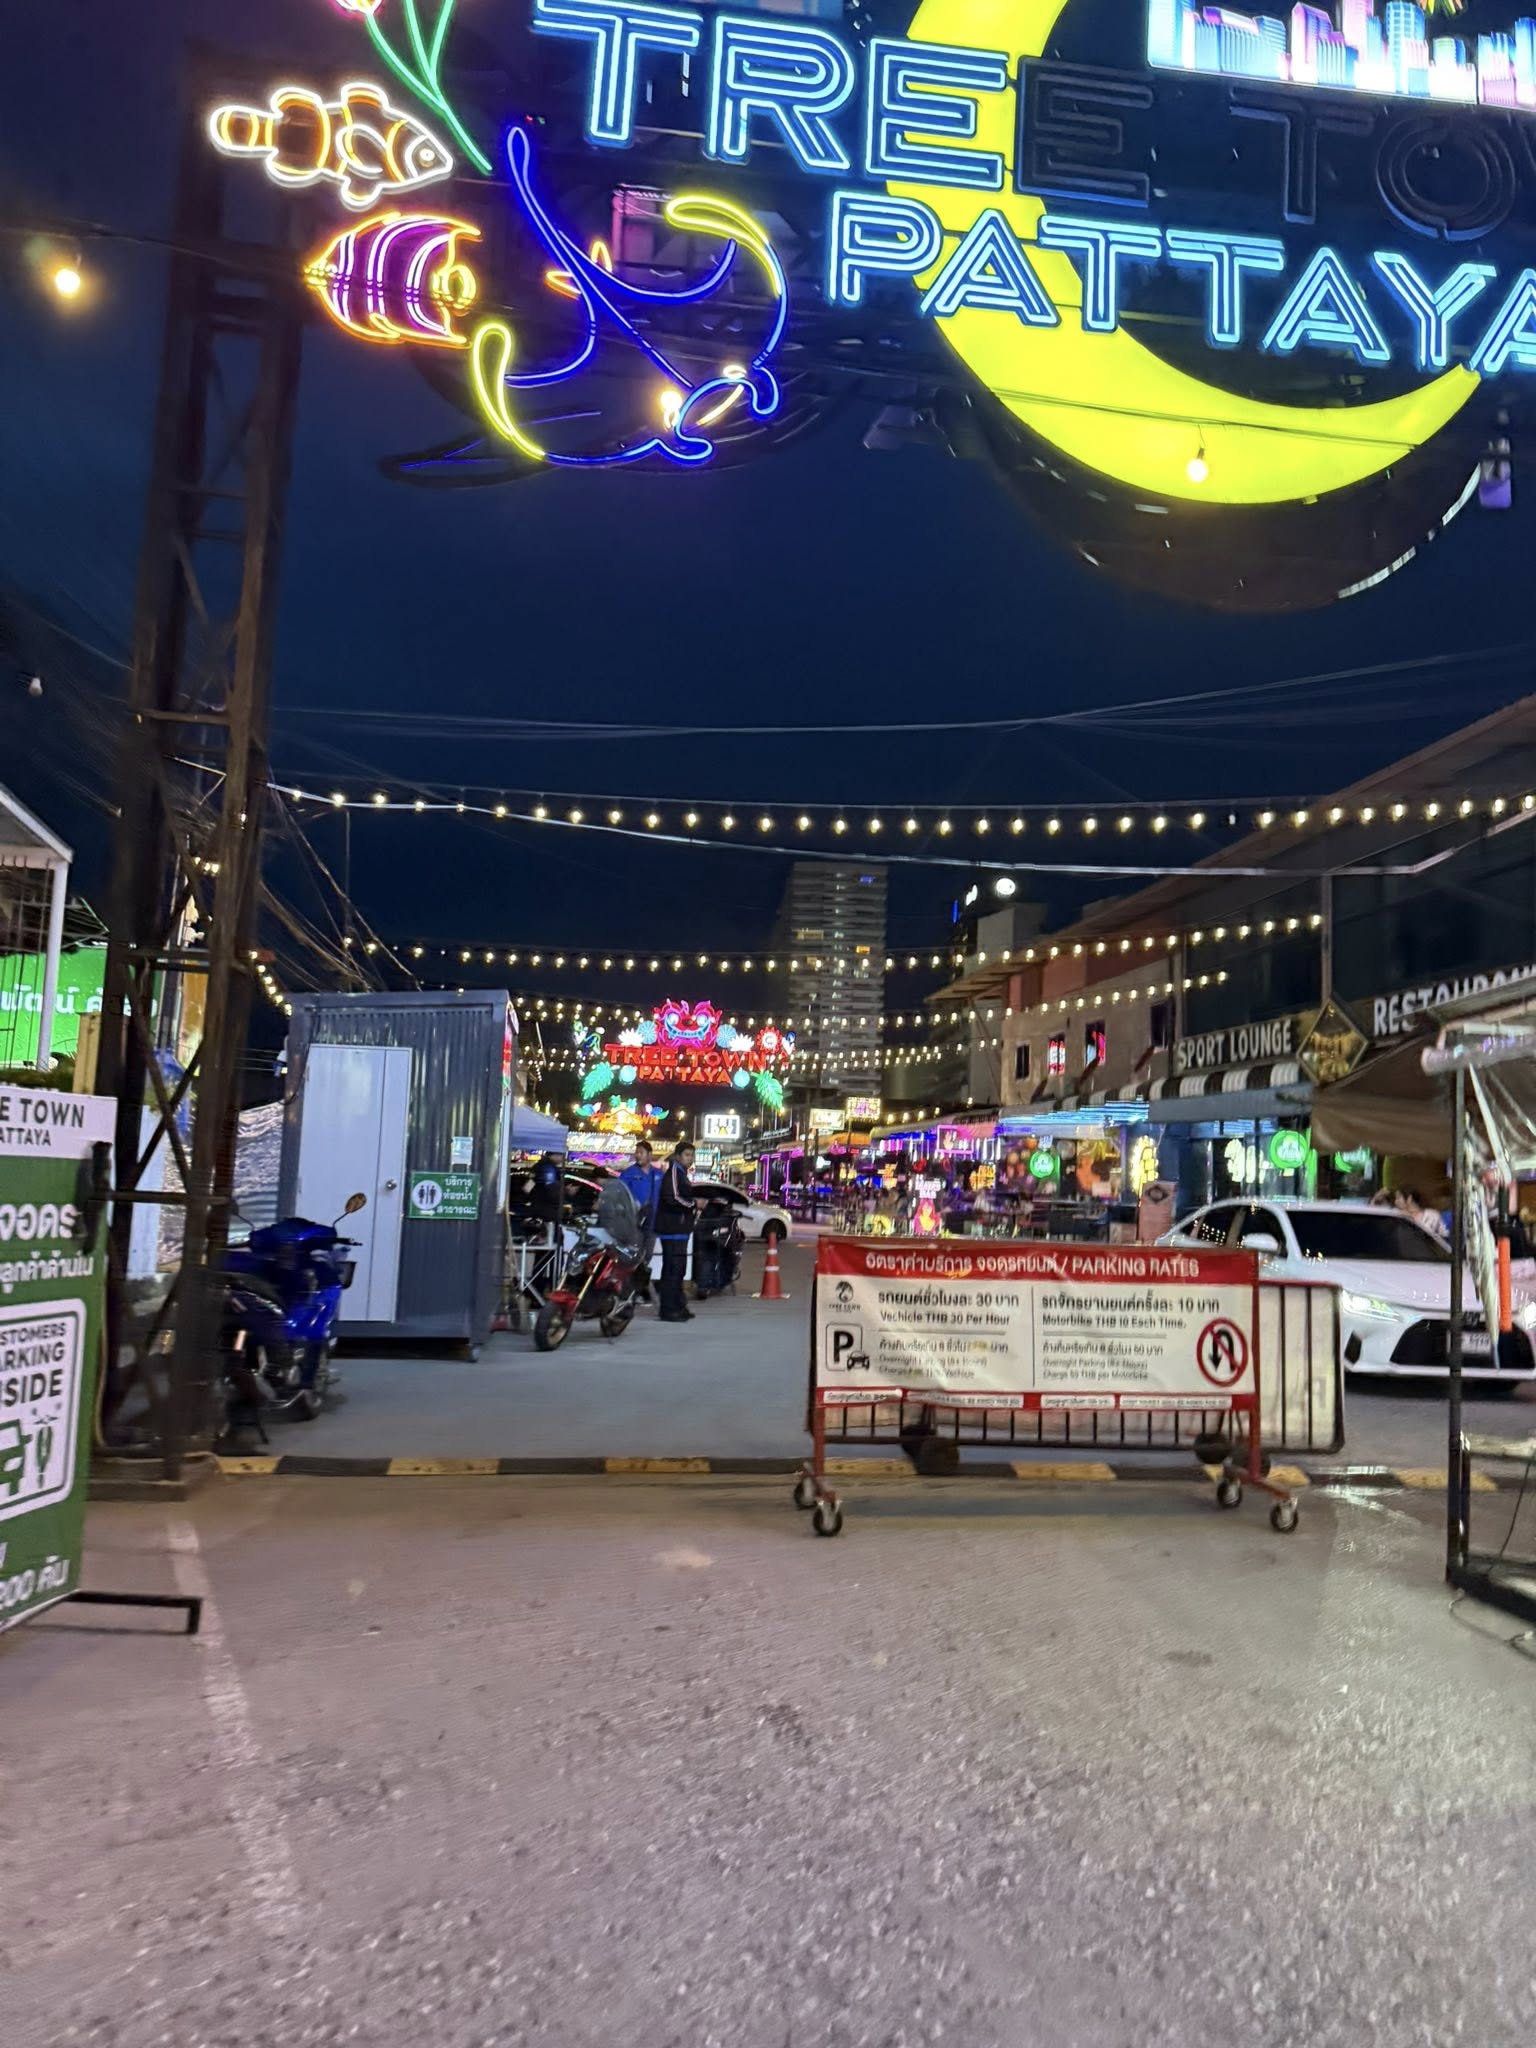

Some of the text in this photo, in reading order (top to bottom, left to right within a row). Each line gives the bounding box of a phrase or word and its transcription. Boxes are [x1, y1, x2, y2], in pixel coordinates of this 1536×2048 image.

[1228, 84, 1536, 242] TO
[1177, 1032, 1226, 1068] SPORT
[1230, 1019, 1292, 1063] LOUNGE
[605, 1043, 768, 1071] TREE TOWN
[638, 1065, 732, 1086] PATTAYA
[20, 1098, 85, 1129] TOWN
[1072, 1255, 1146, 1277] PARKING
[1149, 1257, 1200, 1278] RATES
[976, 1292, 993, 1308] 30
[995, 1293, 1020, 1308] บาท
[1178, 1298, 1194, 1313] 10
[1197, 1298, 1220, 1314] บาท
[925, 1312, 948, 1325] THB
[966, 1314, 984, 1325] Per
[986, 1314, 1010, 1326] Hour
[1042, 1314, 1093, 1326] Motorbike
[1131, 1316, 1156, 1329] Each
[833, 1330, 854, 1363] P
